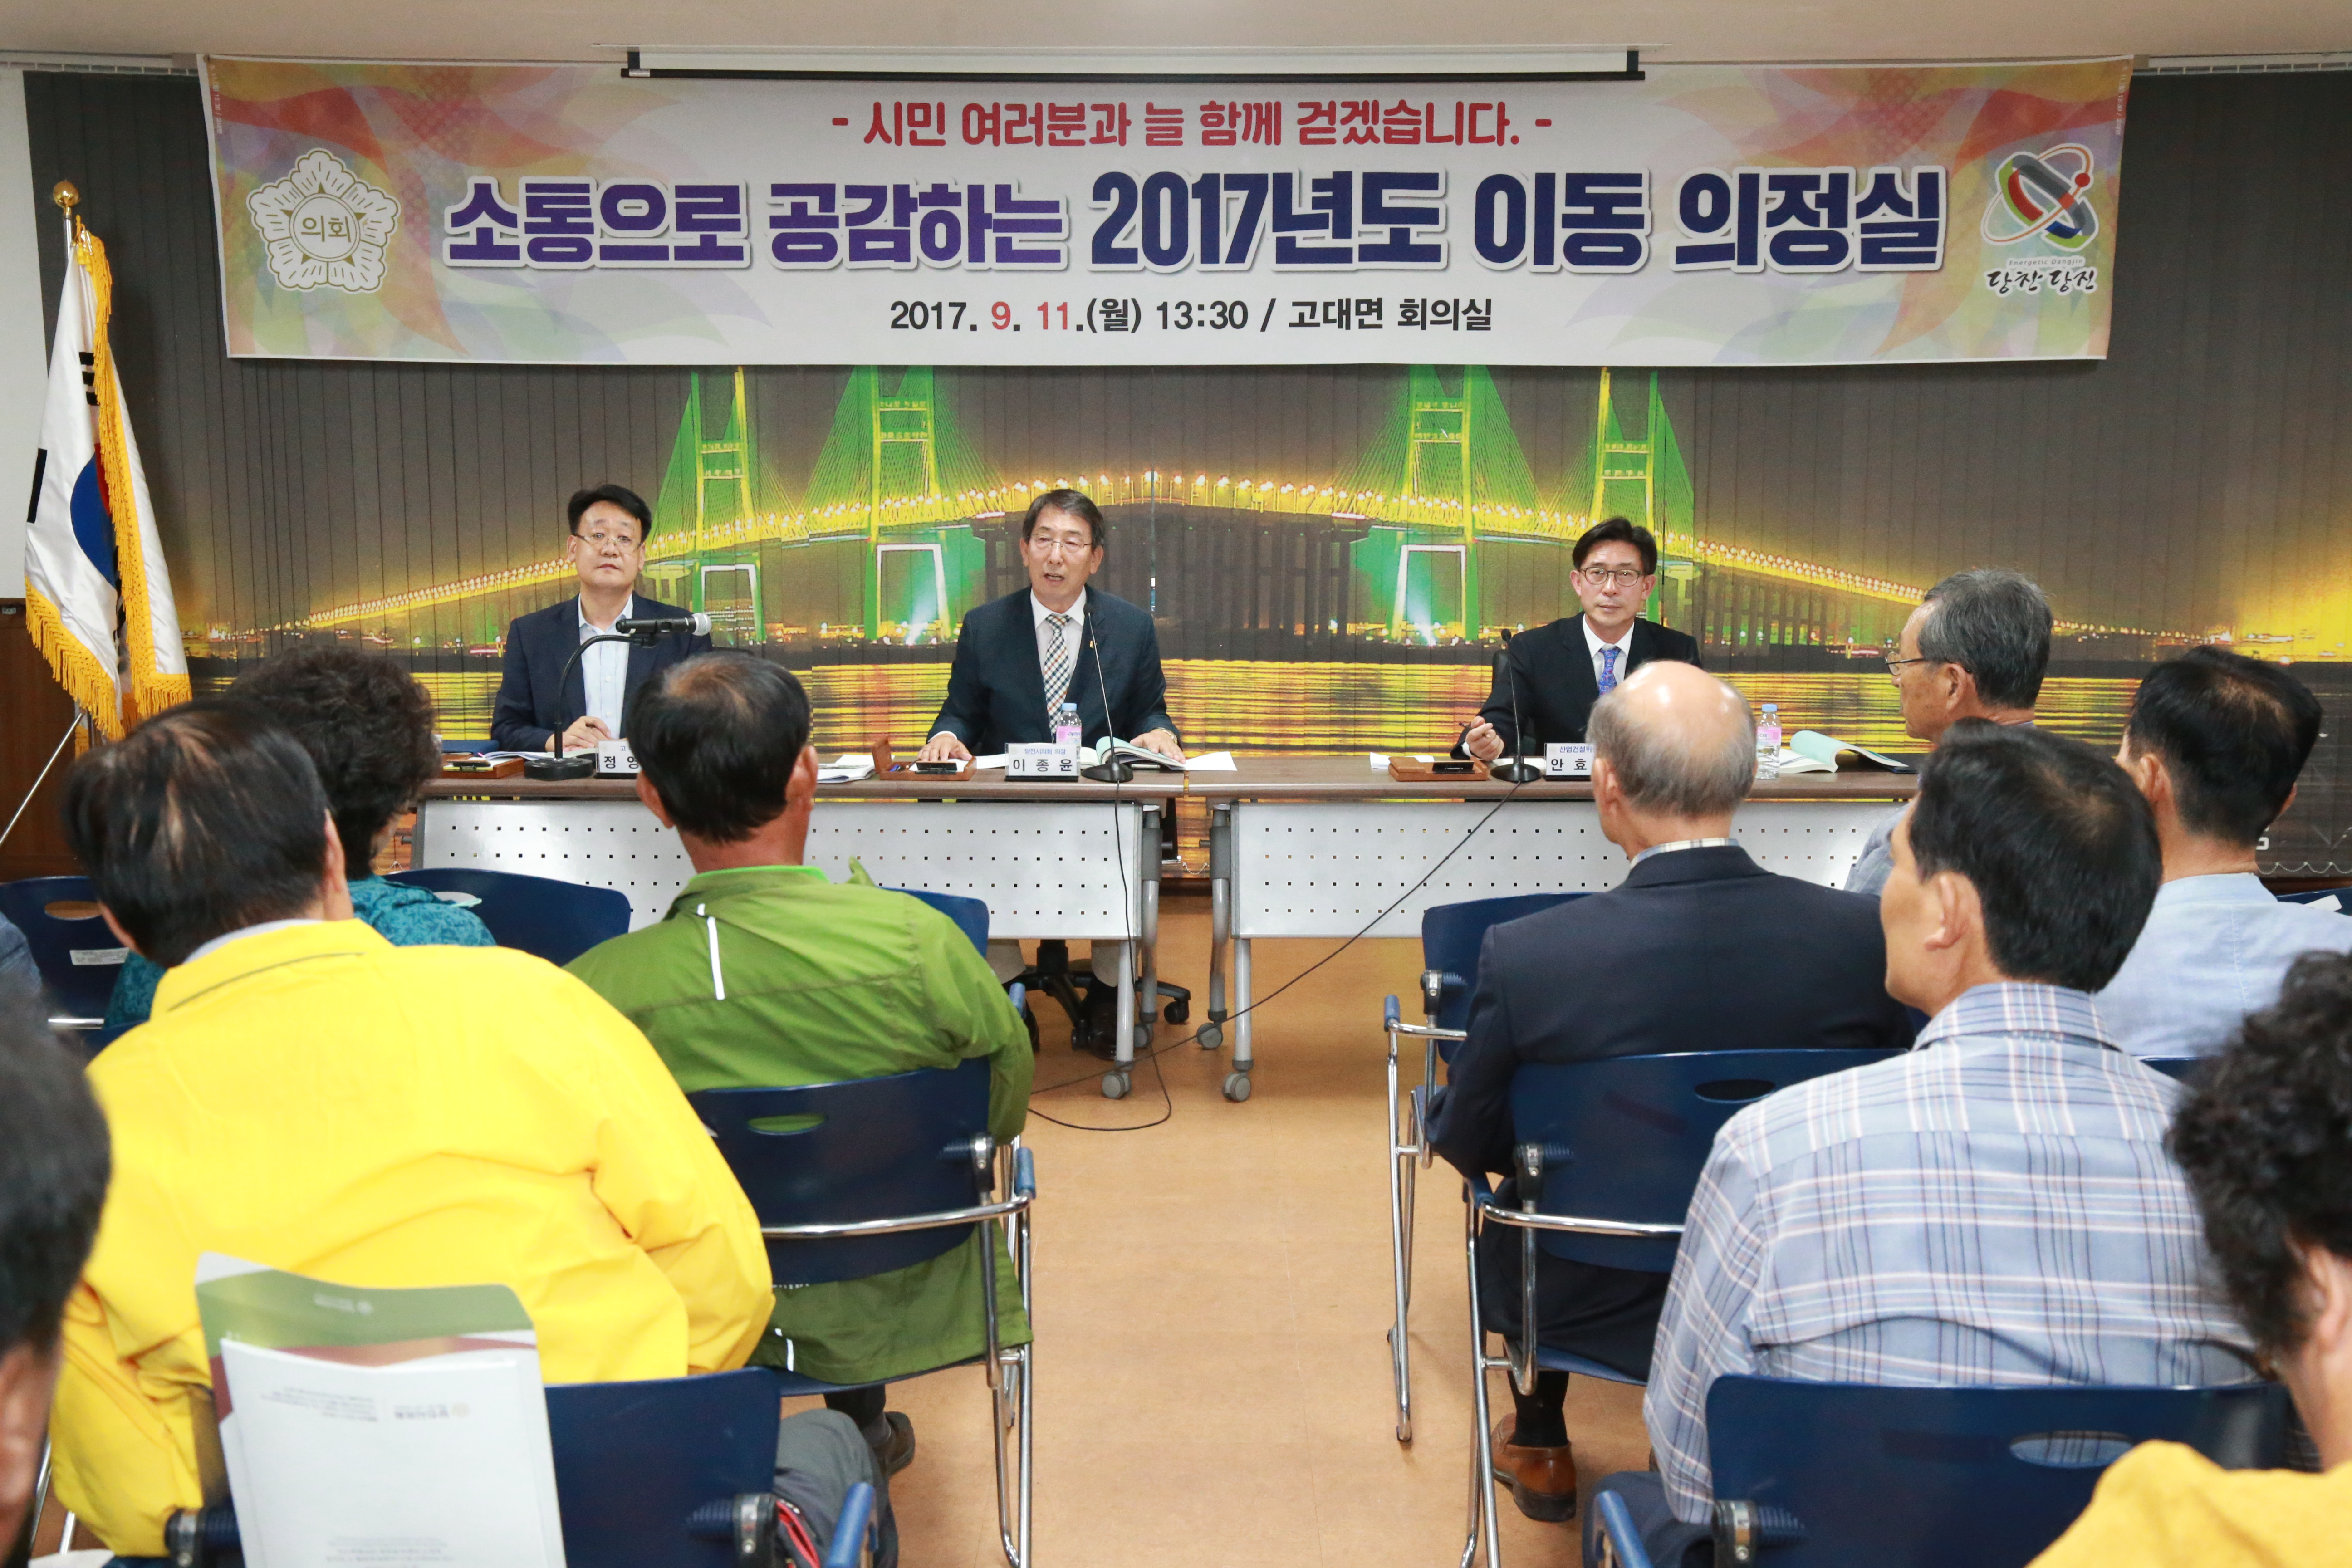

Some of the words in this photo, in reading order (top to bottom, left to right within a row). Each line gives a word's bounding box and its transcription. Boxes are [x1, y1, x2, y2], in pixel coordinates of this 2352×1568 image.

[864, 101, 946, 147] 시민
[962, 102, 1132, 147] 여러분과
[1145, 102, 1184, 146] 늘
[1200, 101, 1282, 146] 함께
[1298, 100, 1520, 146] 걷겠습니다.
[301, 215, 351, 243] 의회
[449, 182, 744, 263] 소통으로
[769, 183, 1063, 263] 공감하는
[1091, 171, 1441, 266] 2017년도
[1474, 172, 1645, 266] 이동
[1675, 171, 1940, 266] 의정실
[2049, 270, 2094, 292] 당진
[890, 301, 977, 331] 2017.
[991, 302, 1020, 331] 9.
[1037, 298, 1141, 333] 11.(월)
[1156, 301, 1249, 330] 13:30
[1289, 298, 1383, 330] 고대면
[1398, 298, 1492, 331] 회의실
